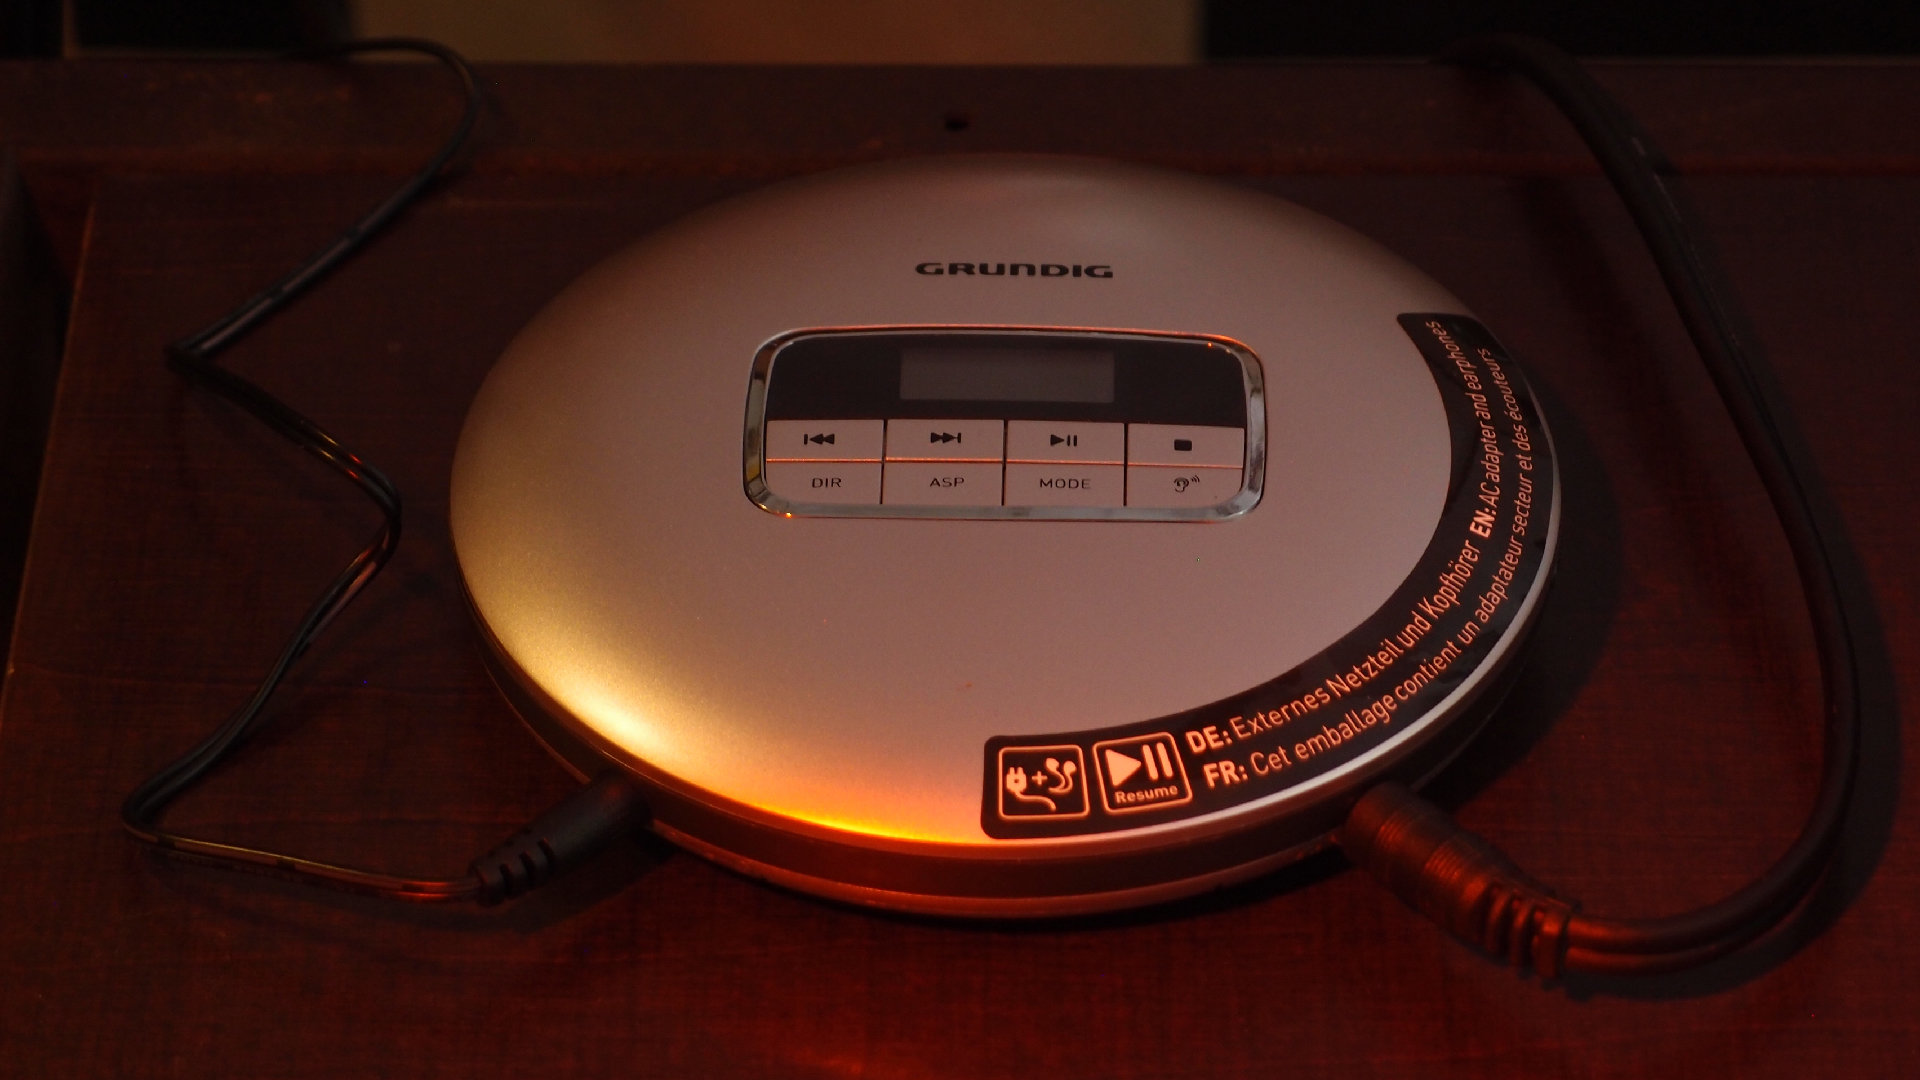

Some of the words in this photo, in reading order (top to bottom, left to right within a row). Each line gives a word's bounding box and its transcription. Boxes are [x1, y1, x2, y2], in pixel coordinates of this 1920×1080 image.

[915, 262, 1114, 278] GRUNDIG
[1425, 320, 1482, 391] earphones
[1477, 347, 1523, 421] écouteurs
[1465, 392, 1491, 420] and
[1480, 421, 1504, 483] adapter
[1511, 424, 1531, 451] des
[1515, 453, 1533, 471] et
[811, 476, 842, 489] DIR
[929, 476, 965, 488] ASP
[1039, 478, 1092, 490] MODE
[1478, 482, 1500, 509] AC
[1512, 473, 1533, 536] secteur
[1469, 507, 1497, 538] EN:
[1418, 540, 1481, 620] Kopfhörer
[1475, 535, 1524, 623] adaptateur
[1396, 610, 1432, 650] und
[1457, 620, 1481, 645] un
[1325, 638, 1405, 699] Netzteil
[1395, 640, 1462, 701] contient
[1229, 686, 1331, 740] Externes
[1294, 694, 1398, 760] emballage
[1185, 726, 1233, 754] DE:
[1203, 760, 1249, 788] FR:
[1250, 745, 1291, 776] Cet
[1115, 784, 1179, 805] Resume
